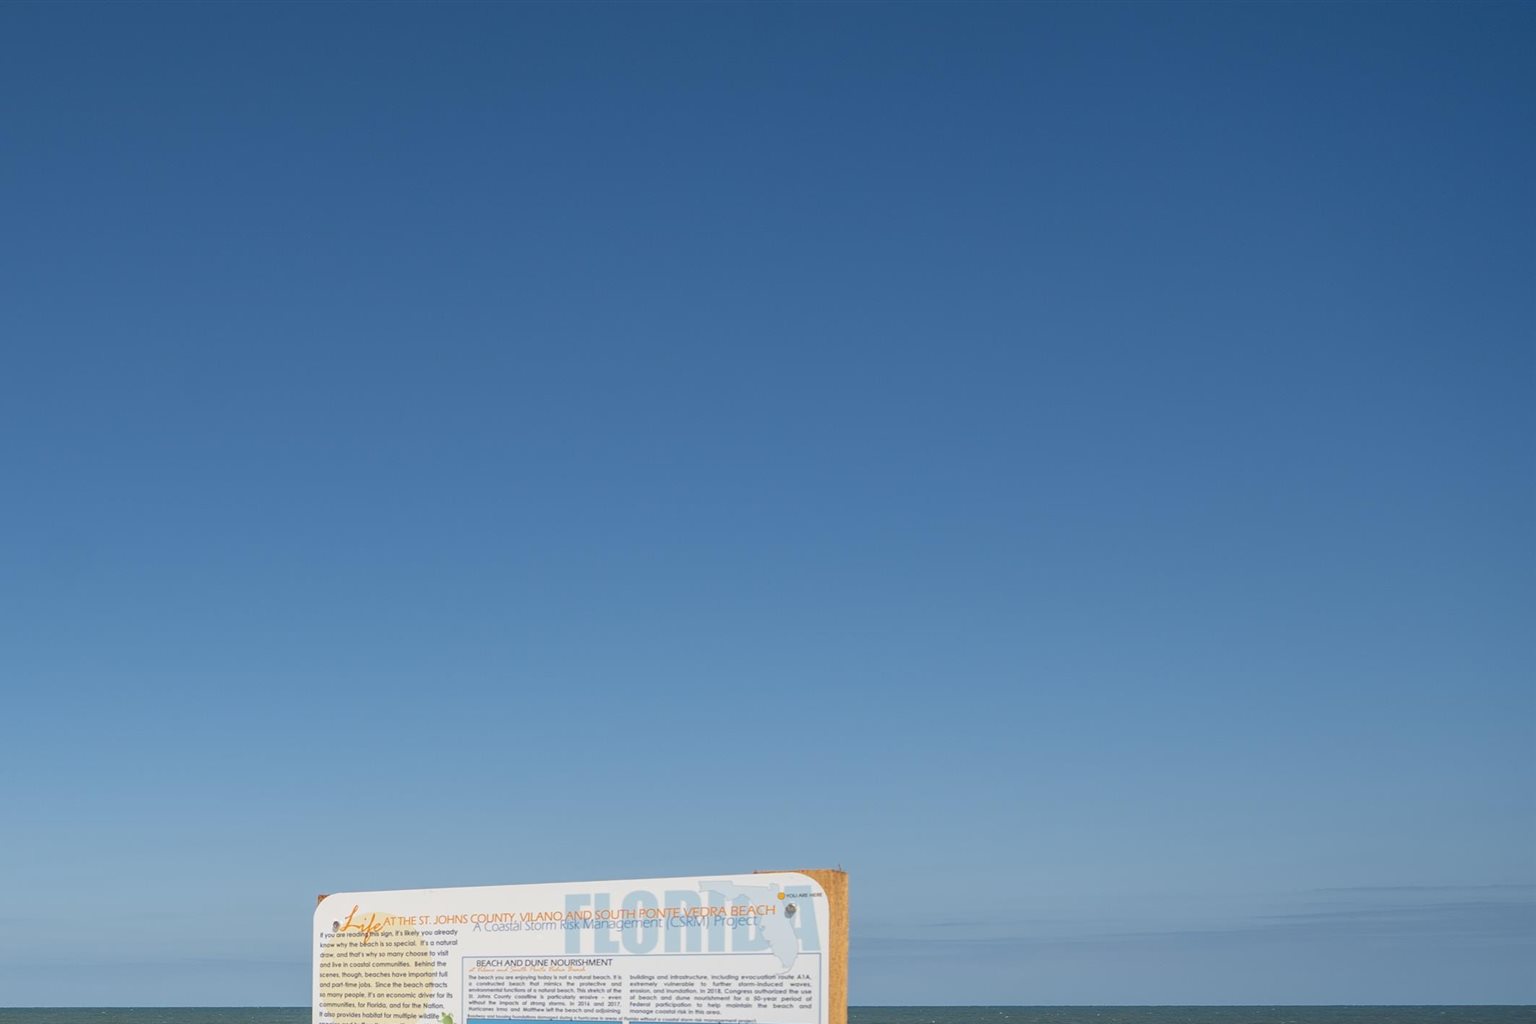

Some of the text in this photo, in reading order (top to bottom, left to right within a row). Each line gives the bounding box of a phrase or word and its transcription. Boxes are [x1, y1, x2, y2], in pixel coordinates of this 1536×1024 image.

[340, 905, 383, 943] Life
[383, 916, 396, 925] AT
[398, 916, 416, 925] THE
[433, 914, 468, 924] JOHNS
[519, 912, 564, 922] VILANO
[564, 911, 593, 920] AND
[594, 910, 637, 920] SOUTH
[639, 909, 682, 918] PONTE
[681, 907, 727, 917] VEDRA
[730, 906, 777, 916] BEACH
[473, 915, 757, 932] A Coastal Storm Risk Management (CSRM) Project
[565, 886, 822, 954] FLORIDA
